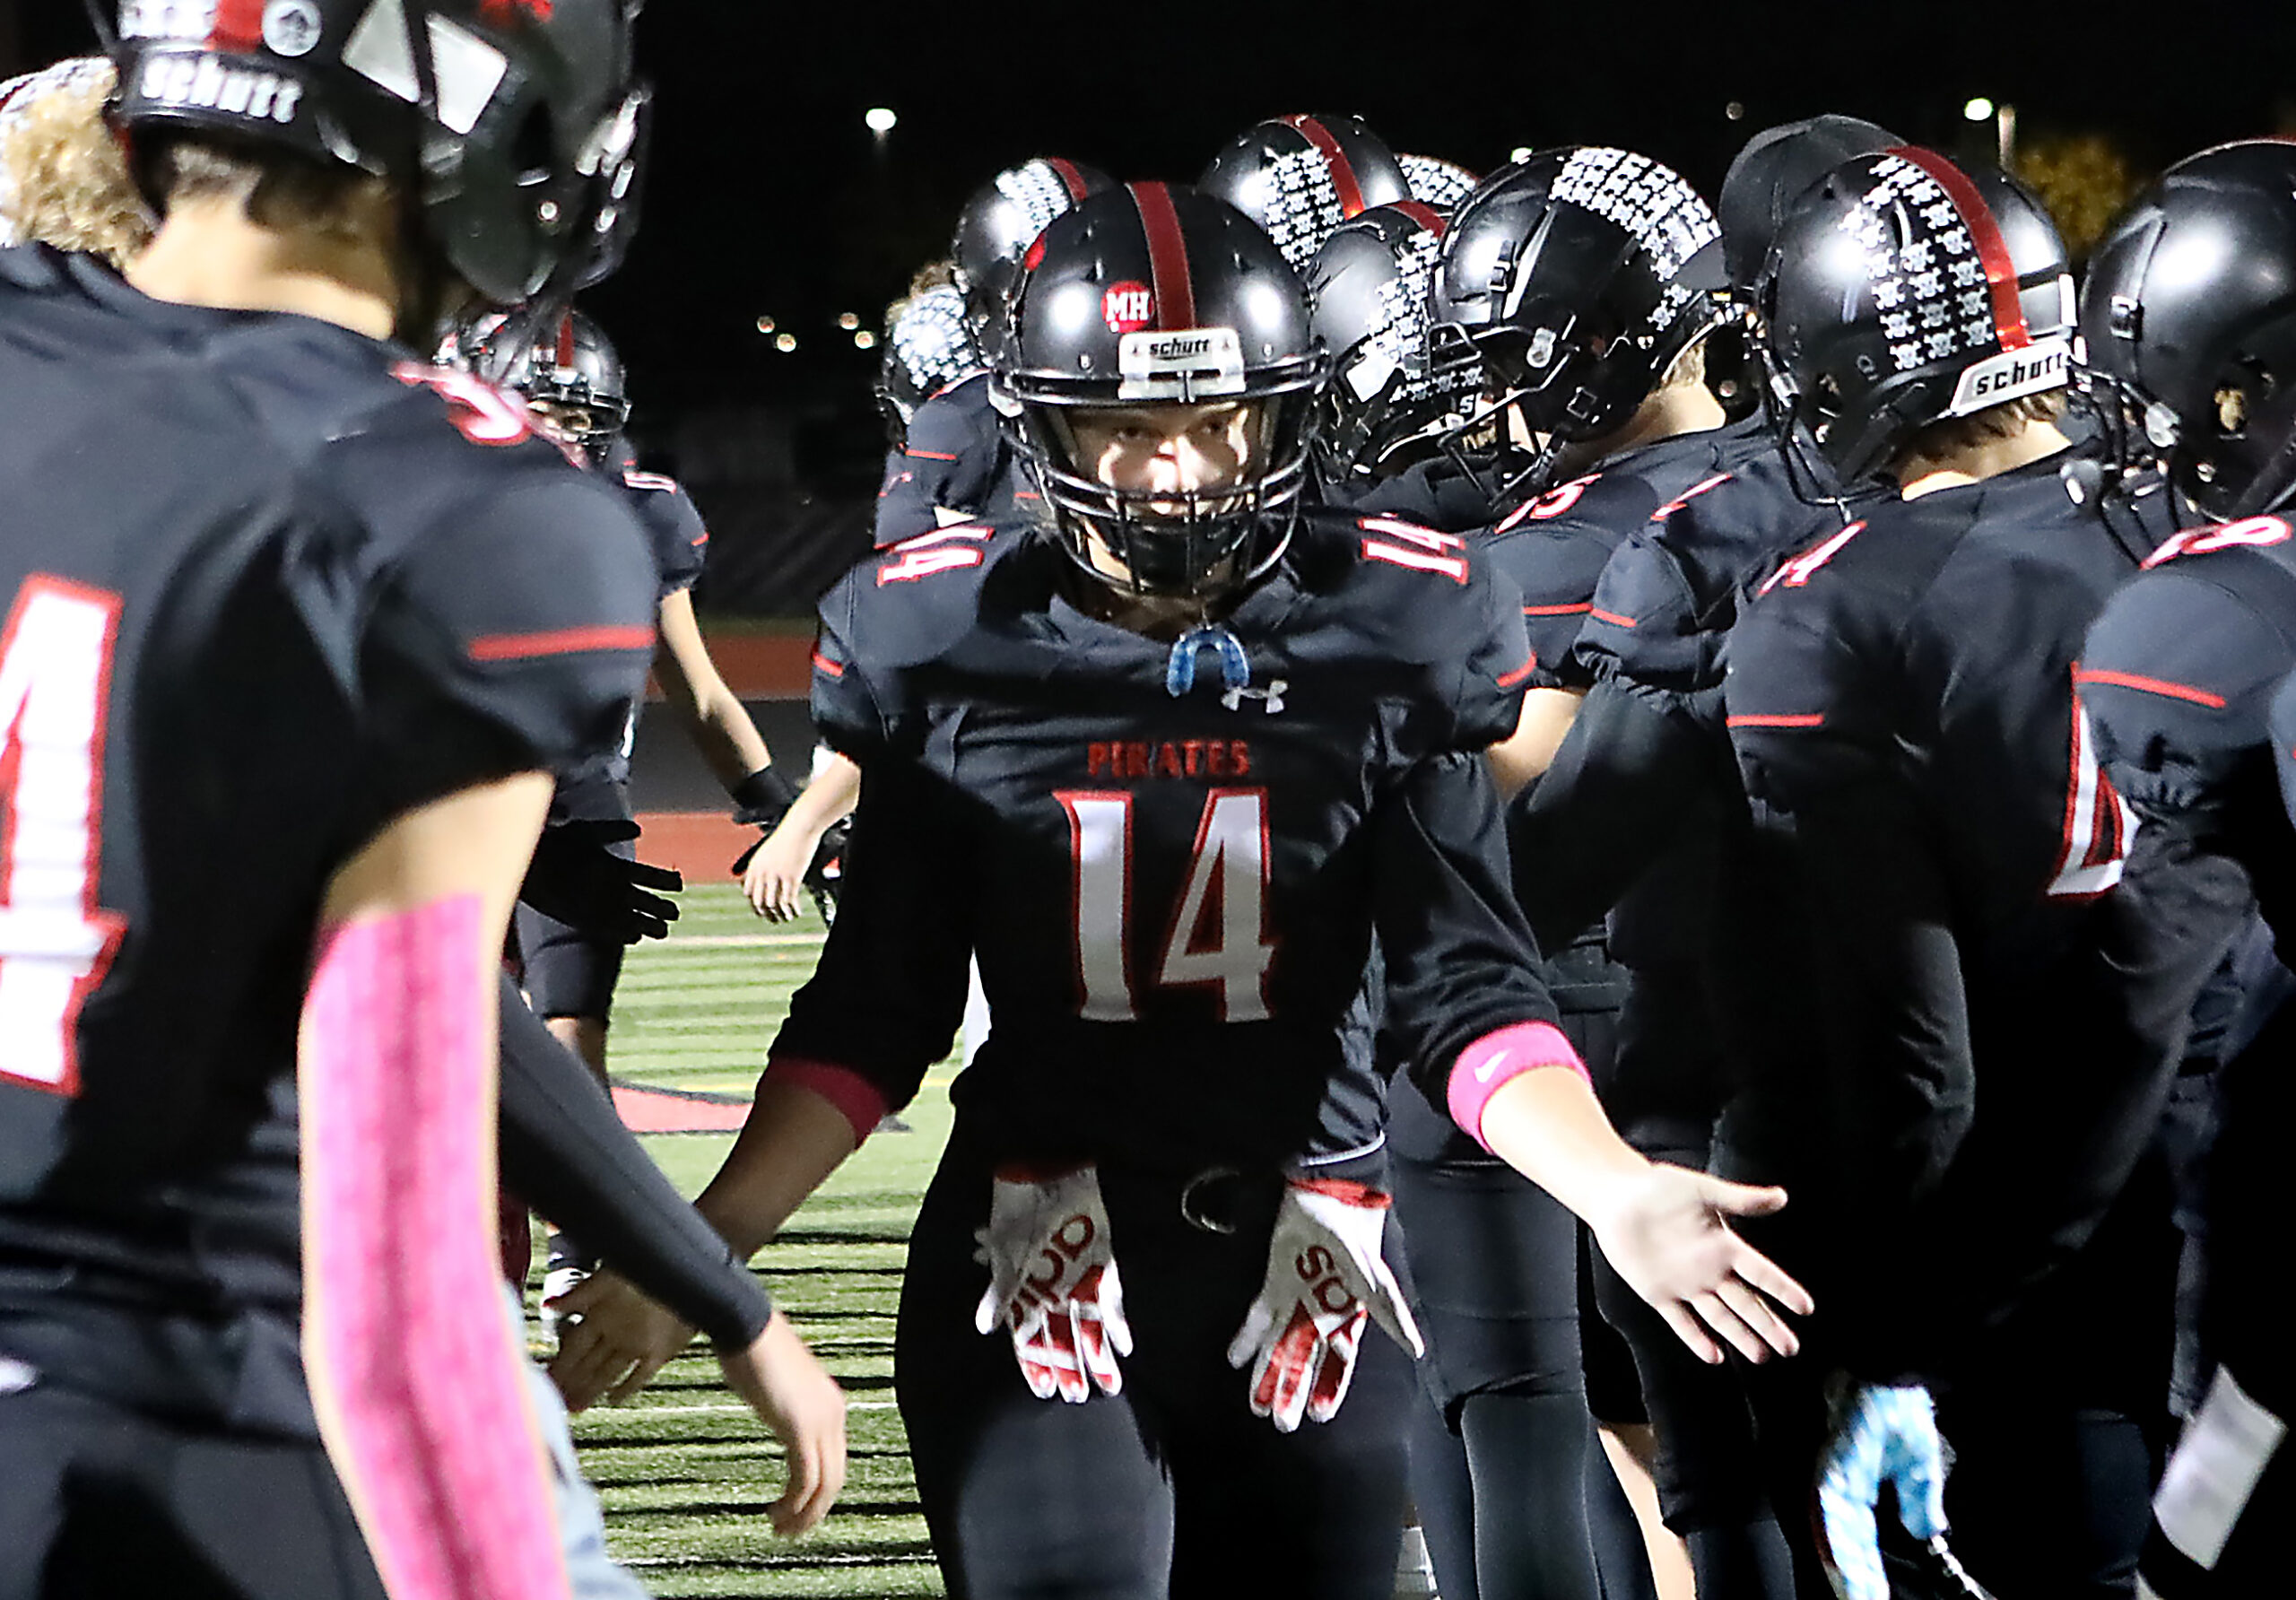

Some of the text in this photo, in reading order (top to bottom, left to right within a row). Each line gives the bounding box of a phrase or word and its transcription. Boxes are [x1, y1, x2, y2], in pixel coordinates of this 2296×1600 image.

[141, 54, 303, 123] schutt
[1106, 291, 1150, 322] MH
[1149, 336, 1210, 356] schutt
[1976, 352, 2063, 396] schutt
[1086, 738, 1251, 778] PIRATES
[1053, 787, 1279, 1023] 14
